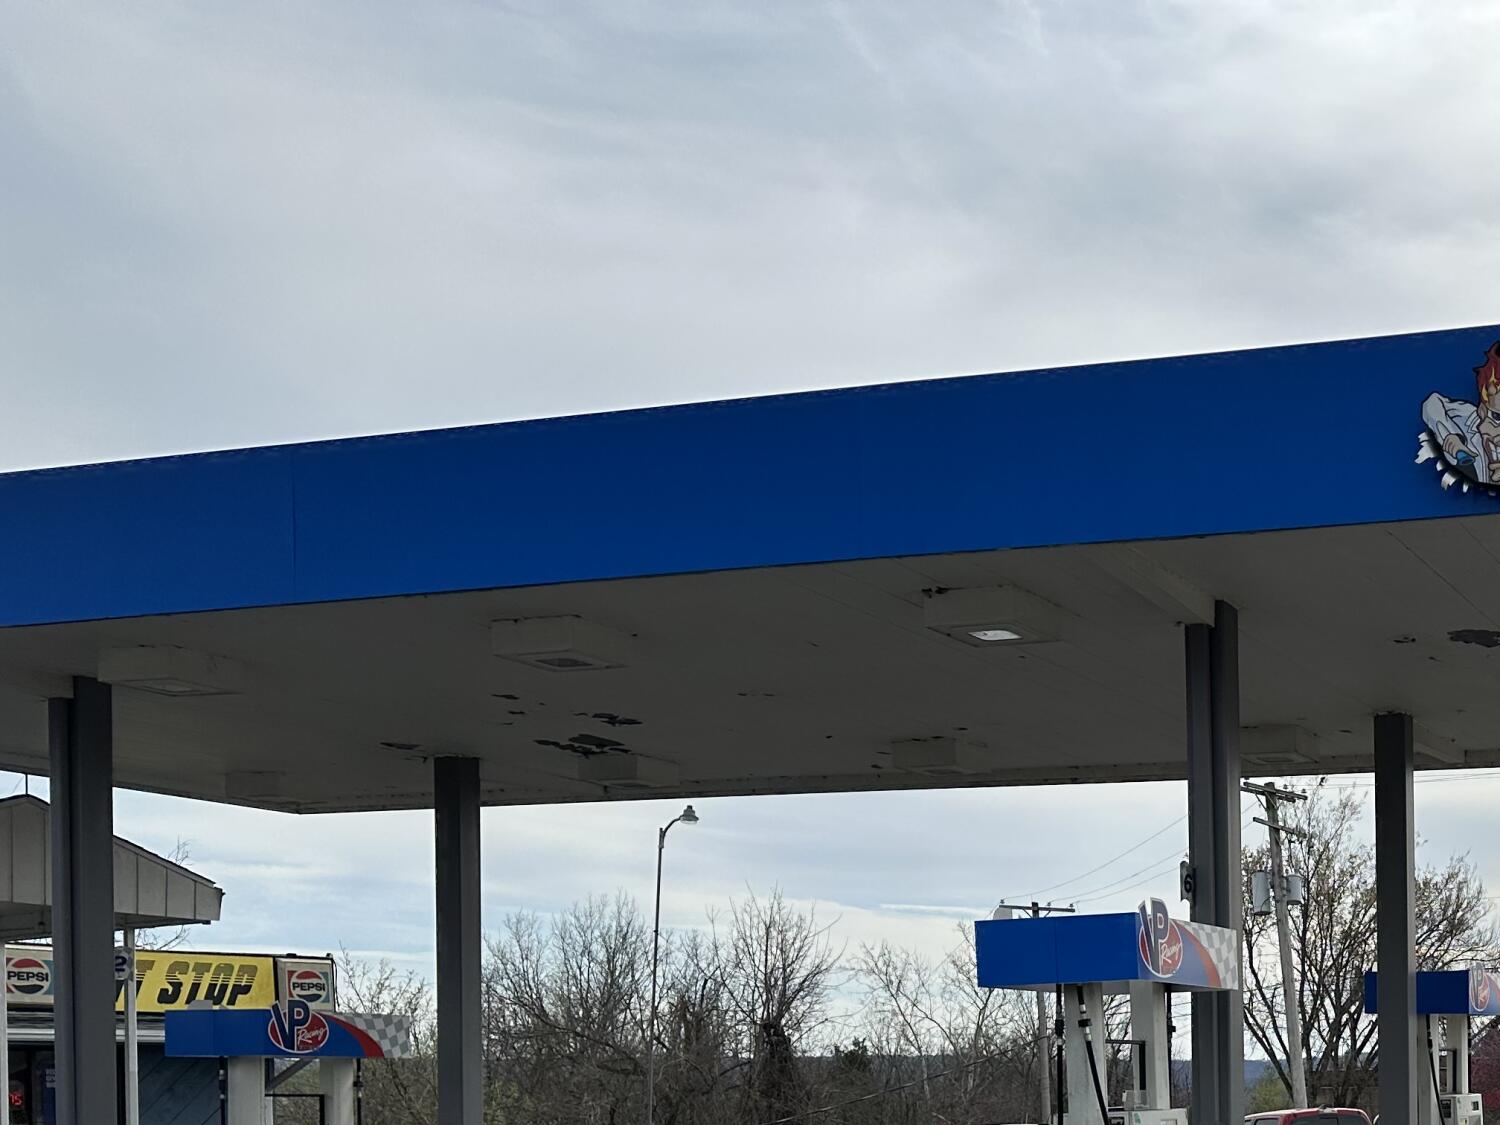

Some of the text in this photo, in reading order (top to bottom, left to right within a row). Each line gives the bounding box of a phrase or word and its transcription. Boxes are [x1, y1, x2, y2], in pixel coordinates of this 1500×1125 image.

[7, 970, 49, 982] PEPSI
[157, 960, 258, 1006] STOP
[291, 981, 326, 992] PEPSI
